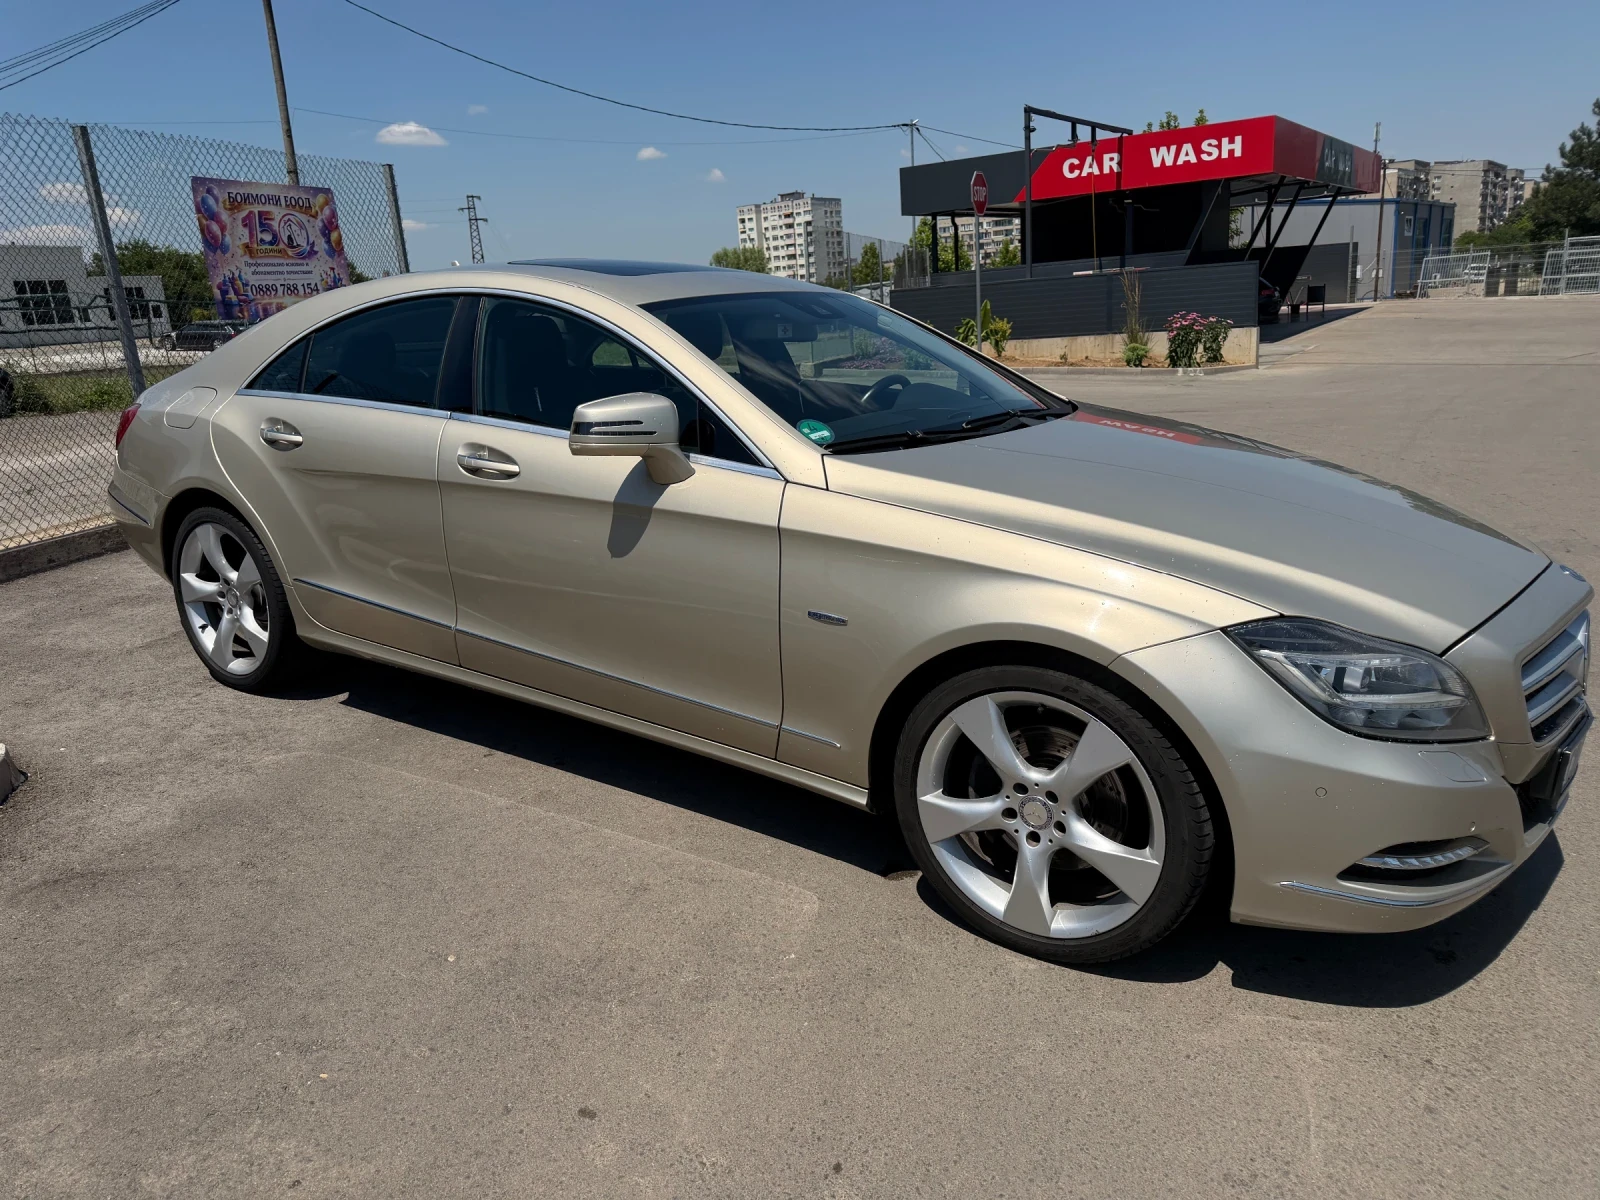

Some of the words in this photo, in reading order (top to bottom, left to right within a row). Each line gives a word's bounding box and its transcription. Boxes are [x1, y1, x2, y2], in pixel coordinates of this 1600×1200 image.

[1062, 152, 1122, 179] CAR
[1149, 135, 1243, 168] WASH
[973, 186, 987, 202] STOP
[284, 196, 313, 210] ЕООД
[251, 284, 278, 297] 0889
[280, 283, 300, 296] 788
[301, 282, 320, 295] 154
